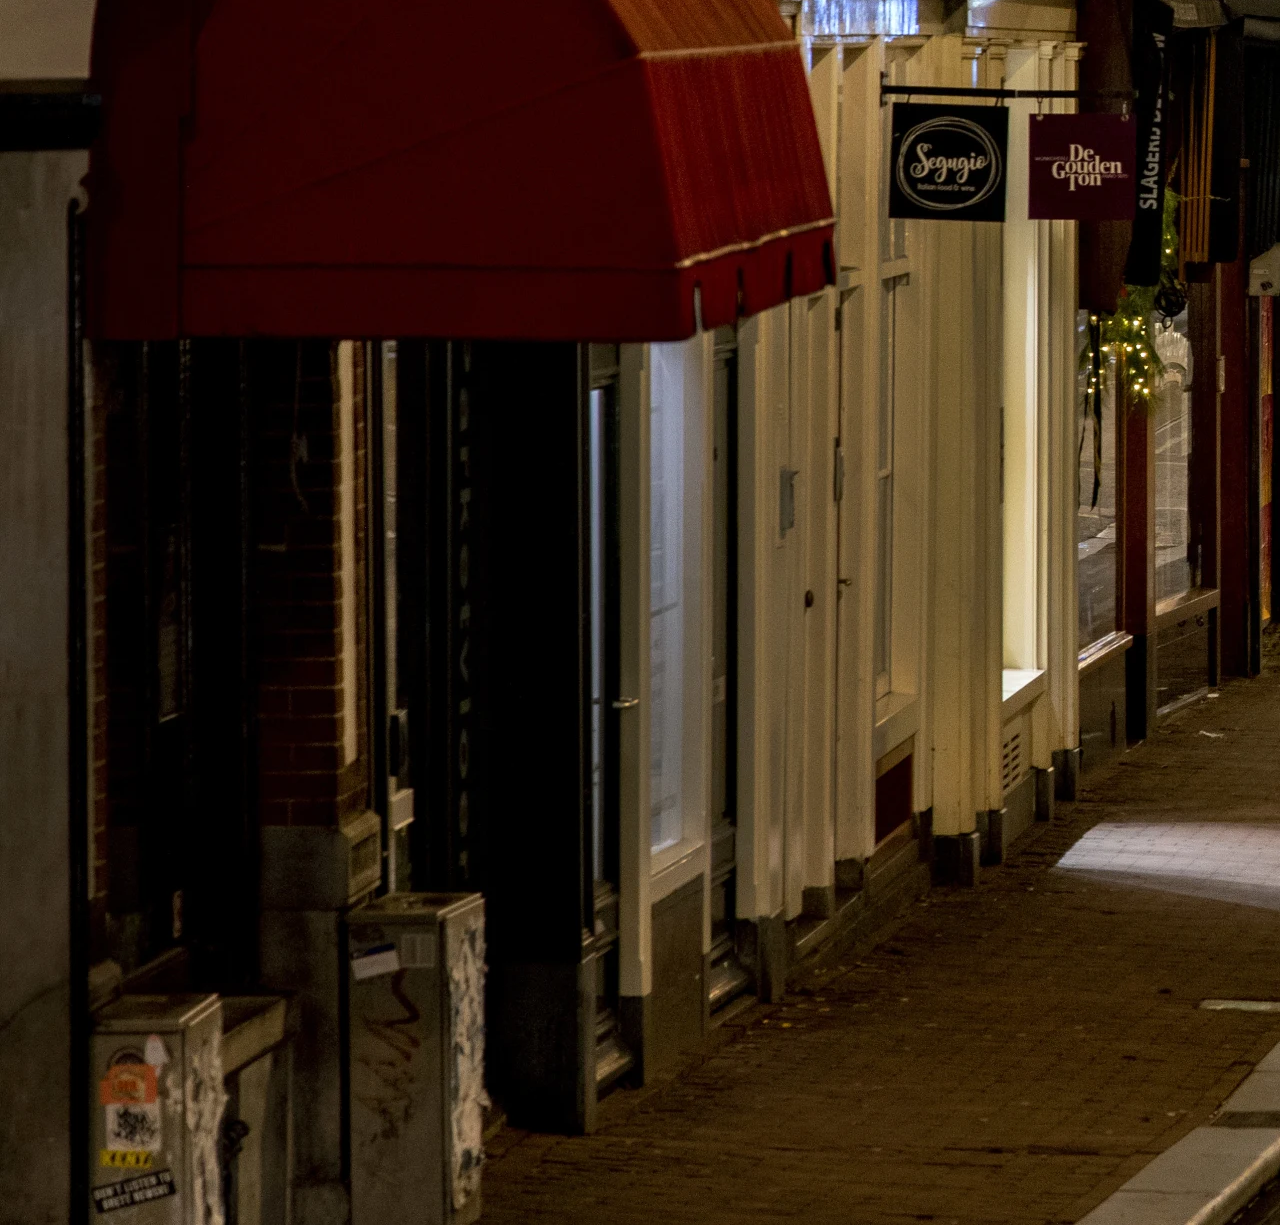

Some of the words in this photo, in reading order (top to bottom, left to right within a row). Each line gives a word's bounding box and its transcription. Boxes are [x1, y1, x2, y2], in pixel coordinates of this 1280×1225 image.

[1070, 143, 1095, 161] De
[909, 143, 990, 184] Segugio
[1052, 155, 1123, 179] Gouden
[1066, 174, 1103, 192] Ton
